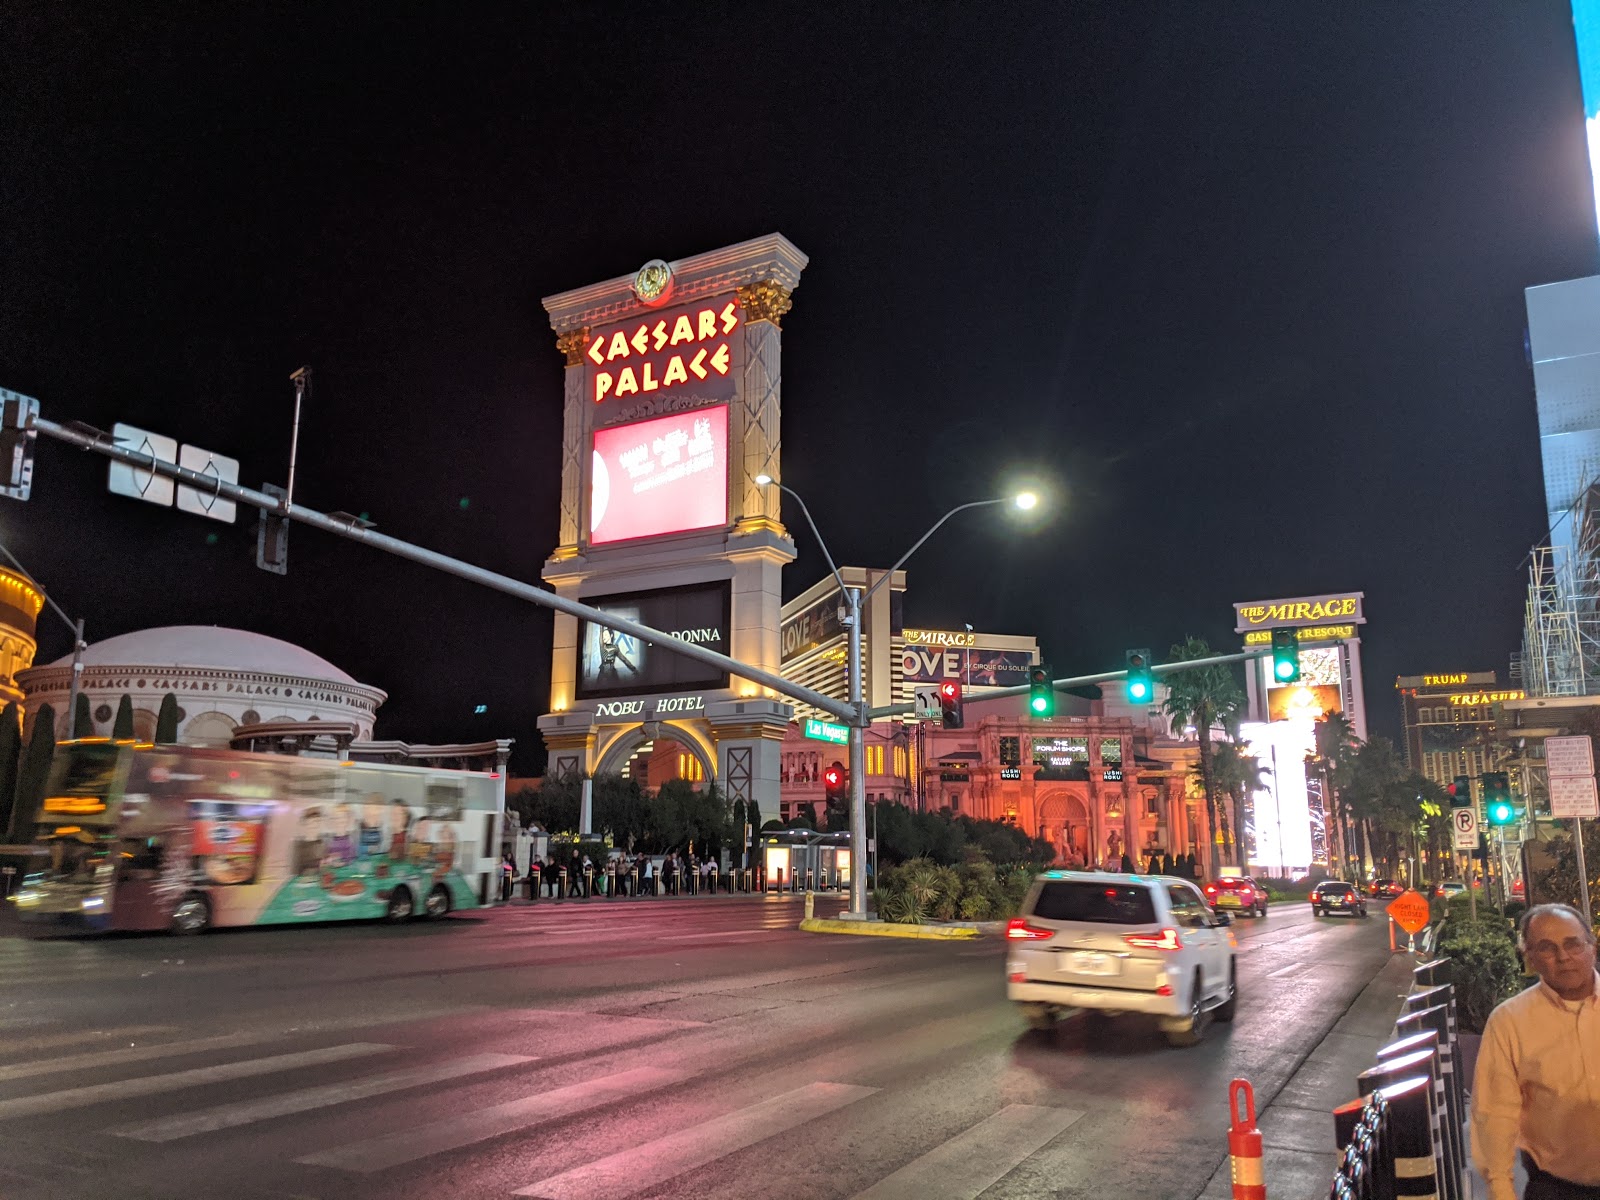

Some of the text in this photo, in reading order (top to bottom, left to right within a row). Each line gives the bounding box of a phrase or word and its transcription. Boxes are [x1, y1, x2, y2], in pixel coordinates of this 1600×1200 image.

[588, 302, 738, 365] CAESARS
[595, 343, 730, 401] PALACE
[1240, 598, 1356, 620] THE MIRAGE
[662, 628, 721, 643] DONNA
[781, 616, 811, 658] LOVE
[903, 630, 975, 646] THE MIRAGE
[1246, 631, 1272, 642] CASI
[1305, 626, 1354, 638] RESORT
[902, 650, 960, 678] OVE
[972, 663, 996, 671] CIRQUE
[1424, 674, 1468, 685] TRUMP
[82, 679, 130, 689] PALACE
[152, 679, 218, 691] CAESARS
[226, 681, 278, 695] PALACE
[298, 690, 343, 704] CAESARS
[596, 696, 705, 717] NOBU HOTEL
[809, 720, 822, 736] Las
[822, 722, 842, 741] Vegas
